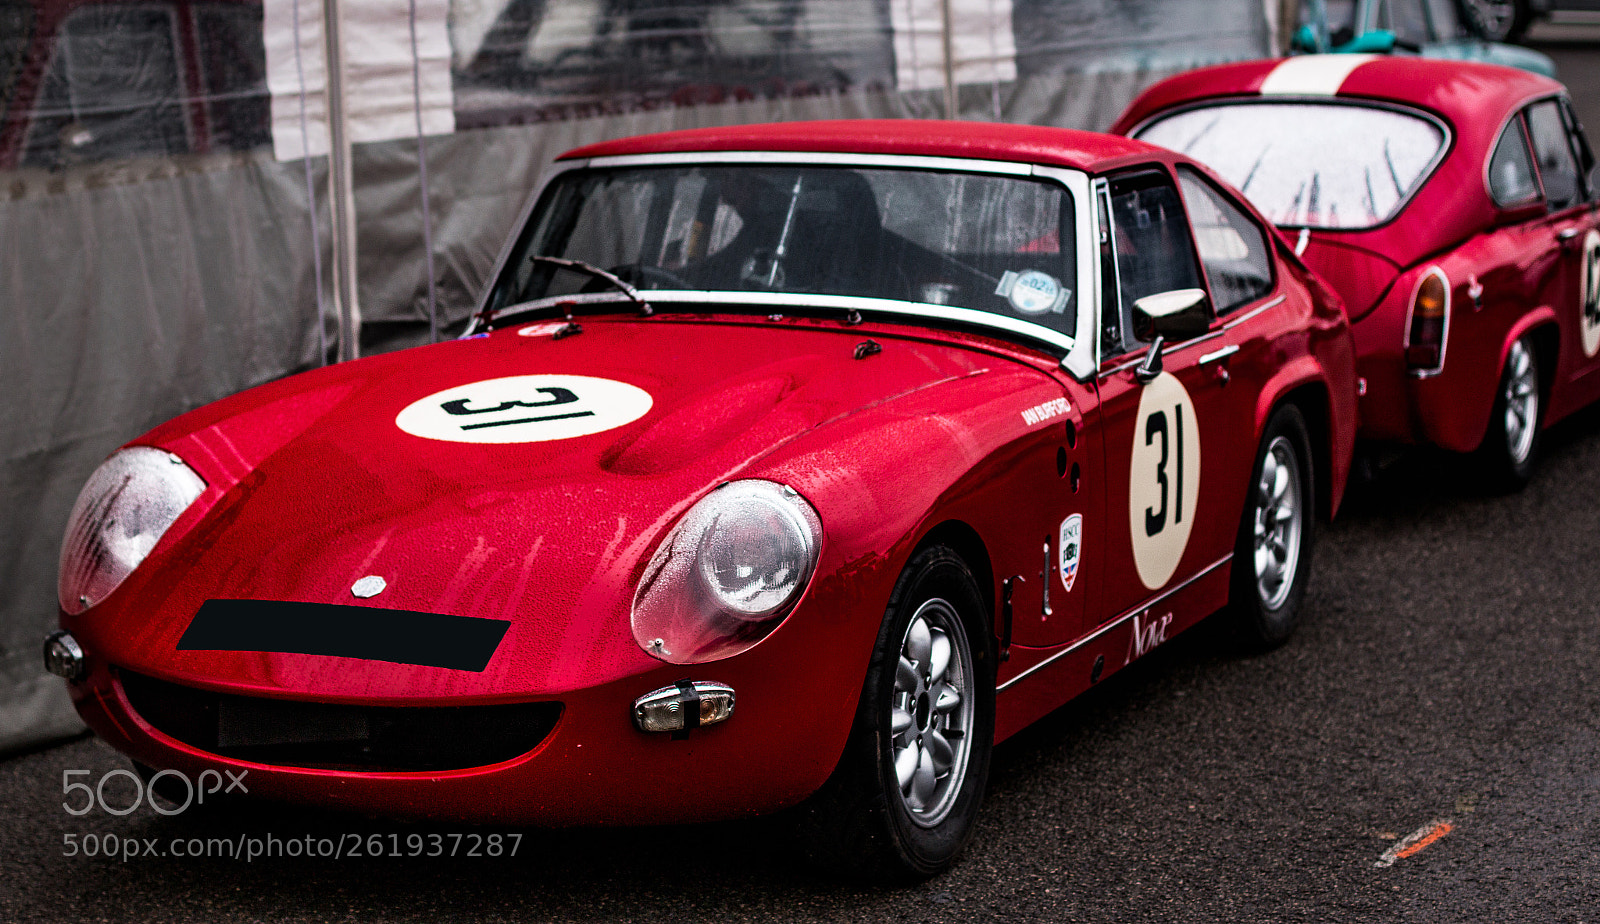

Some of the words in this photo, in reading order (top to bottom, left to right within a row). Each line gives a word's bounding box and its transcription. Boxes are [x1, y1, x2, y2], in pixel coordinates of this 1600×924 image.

[440, 387, 595, 430] 31
[1033, 397, 1071, 421] BURFORD
[1145, 403, 1184, 538] 31
